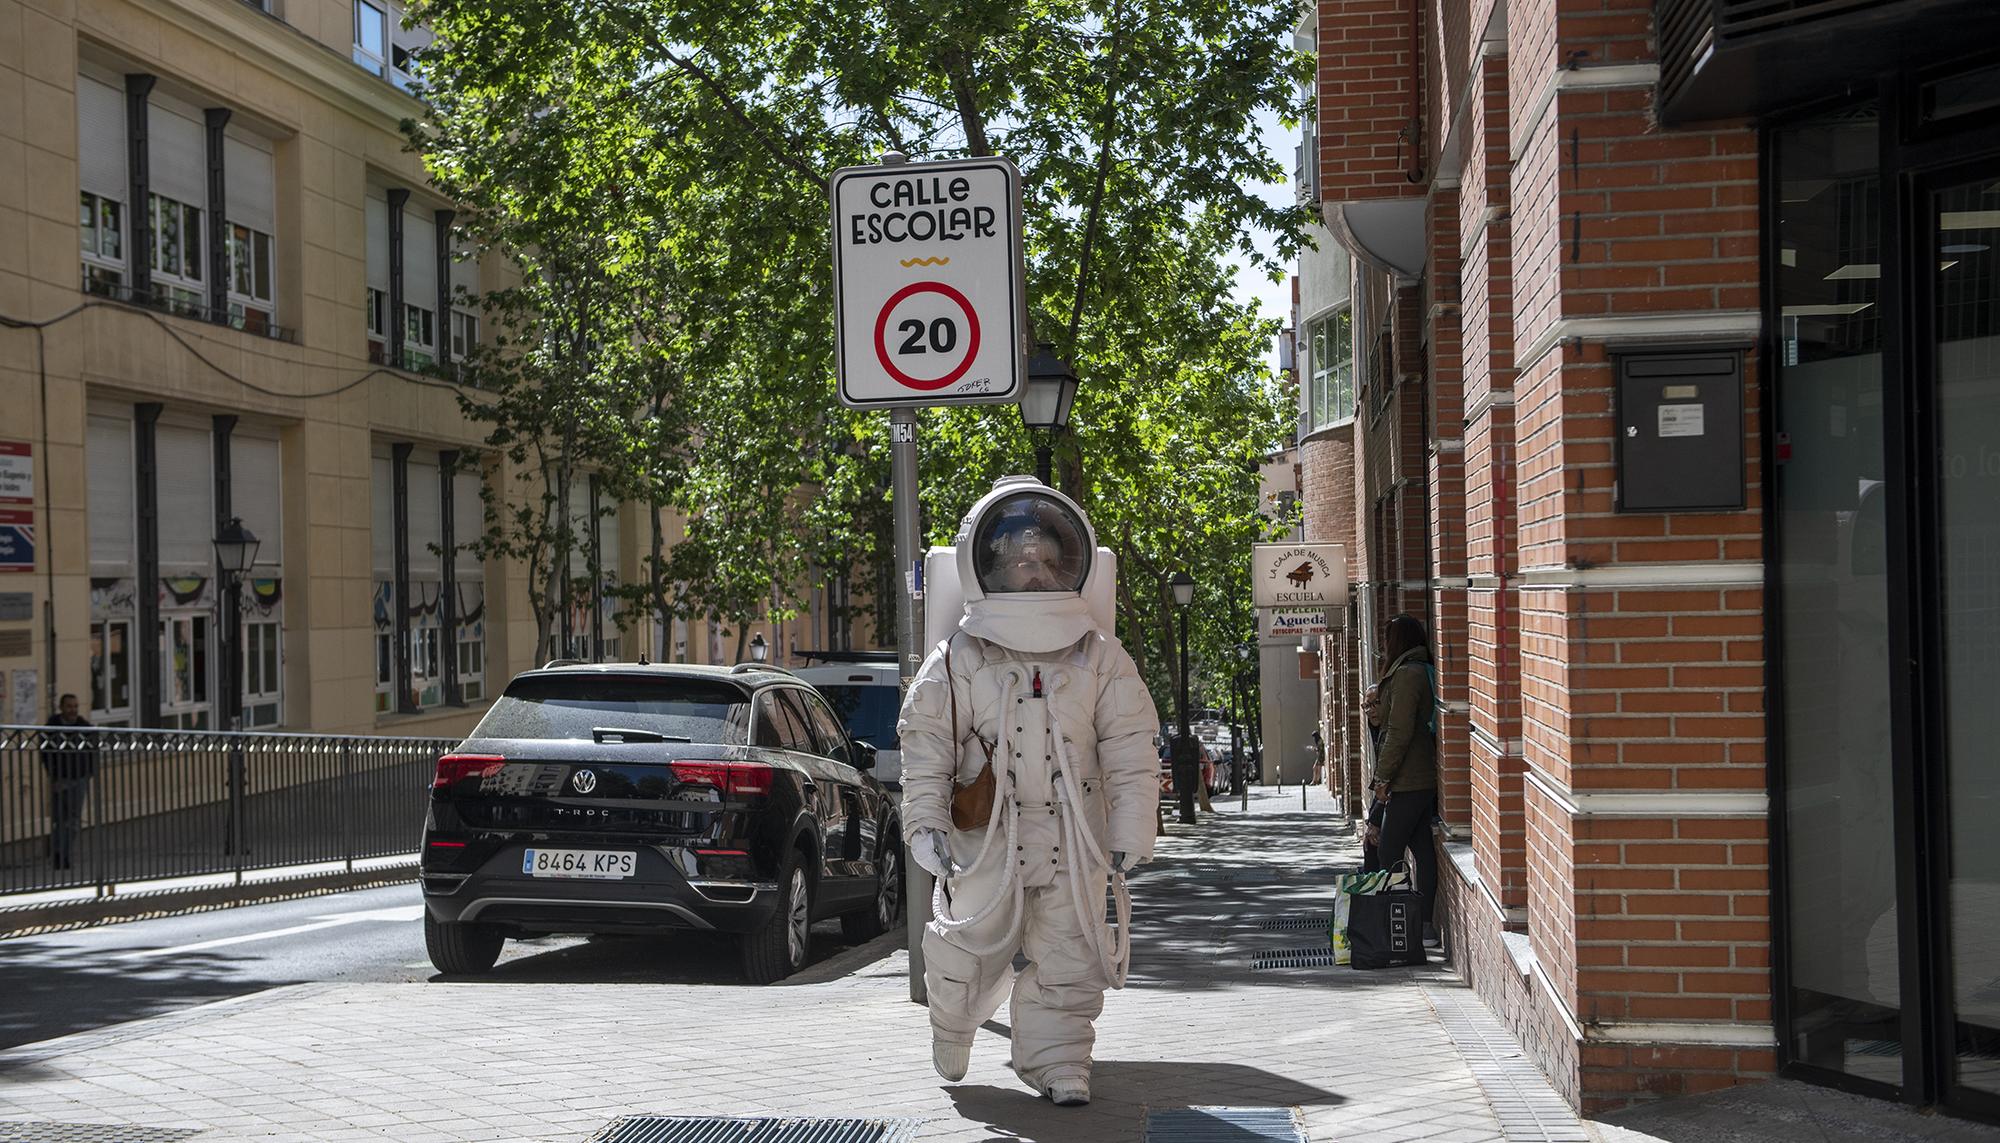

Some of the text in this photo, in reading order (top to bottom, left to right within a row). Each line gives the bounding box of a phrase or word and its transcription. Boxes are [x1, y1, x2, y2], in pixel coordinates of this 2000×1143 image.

[851, 206, 996, 245] ESCOLAR
[897, 317, 957, 355] 20
[1269, 549, 1330, 579] LA CAJA DE MUSICA
[1277, 592, 1324, 602] ESCUELA
[1273, 614, 1327, 627] Agueda
[537, 852, 632, 873] 8464 KPS
